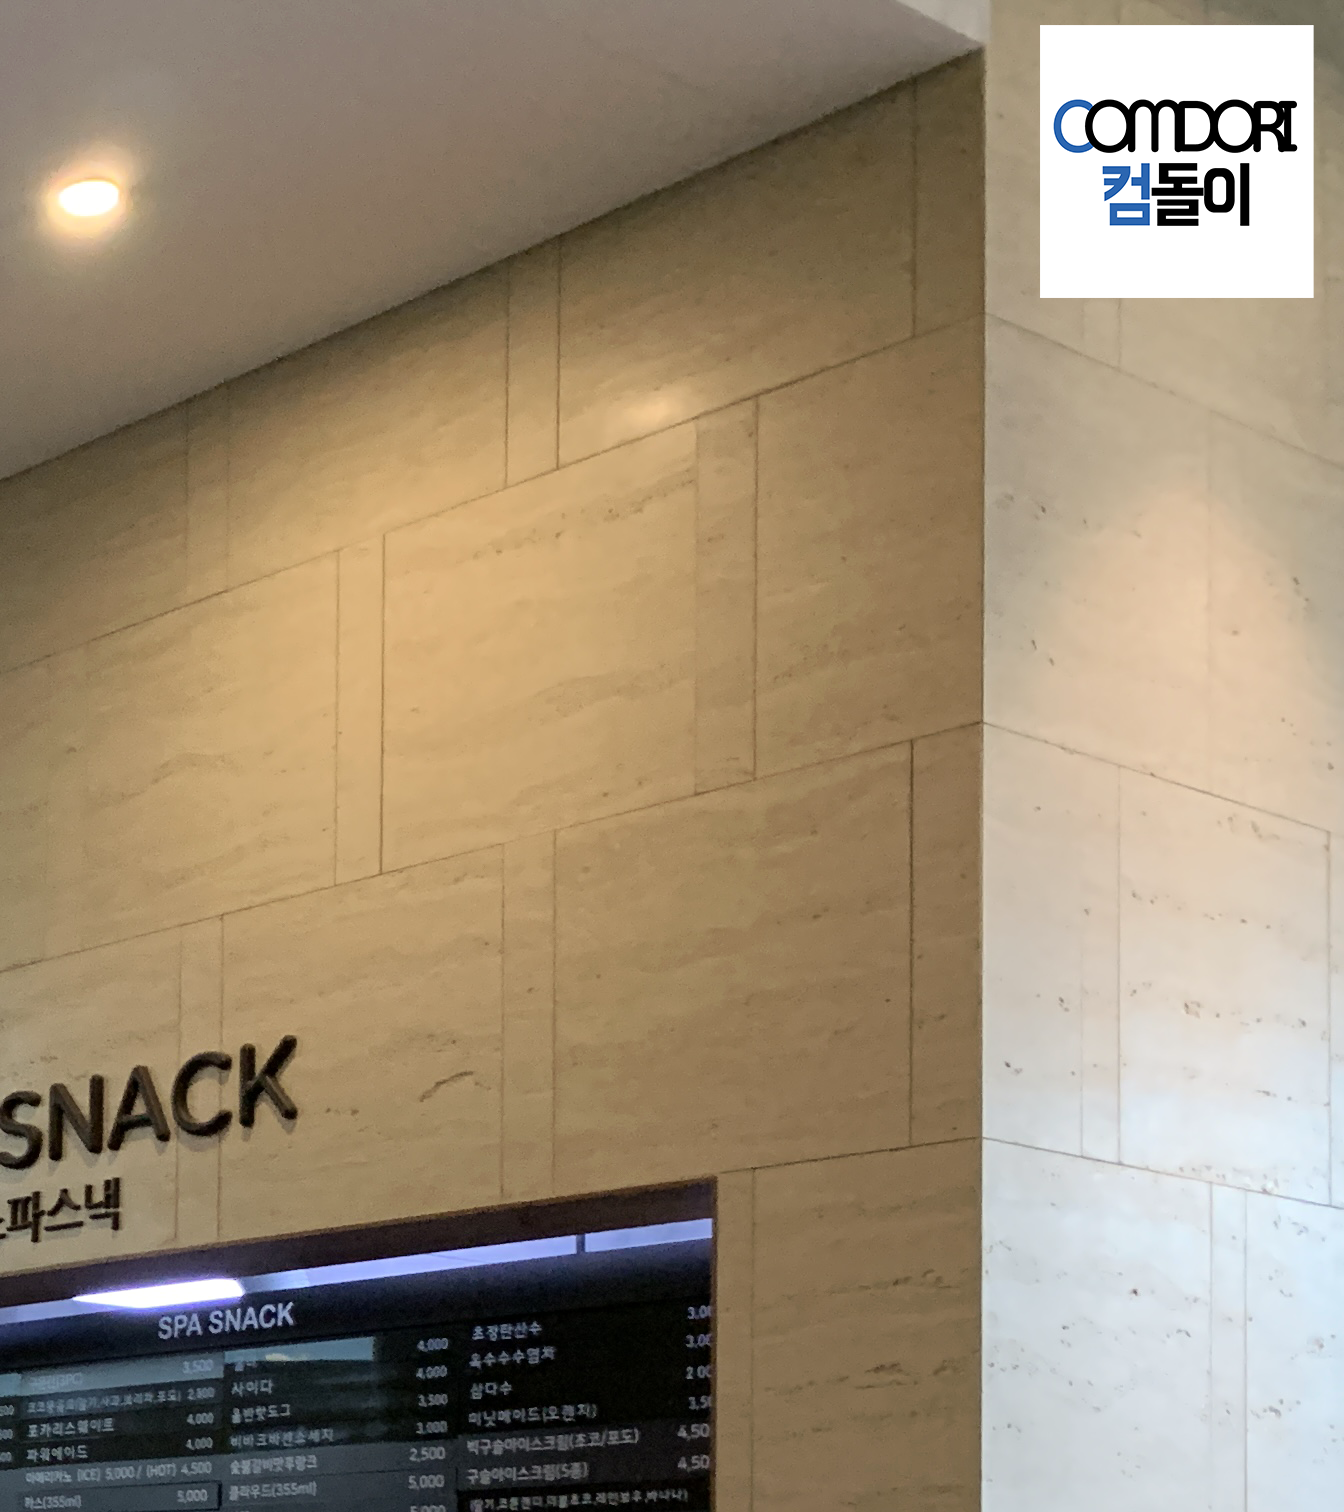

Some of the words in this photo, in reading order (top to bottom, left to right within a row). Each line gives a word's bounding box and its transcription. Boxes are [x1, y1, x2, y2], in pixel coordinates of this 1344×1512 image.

[158, 1310, 202, 1341] SPA
[209, 1301, 295, 1333] SNACK
[468, 1346, 558, 1370] 옥수수수염차
[231, 1379, 274, 1398] 사이다
[469, 1380, 513, 1400] 삼다수
[28, 1417, 114, 1438] 포카리스웨이트
[26, 1444, 89, 1463] 파워에이드
[408, 1446, 446, 1463] 2,500
[407, 1474, 445, 1491] 5,000
[24, 1494, 82, 1510] 카스(355ml)
[176, 1488, 208, 1504] 5,000
